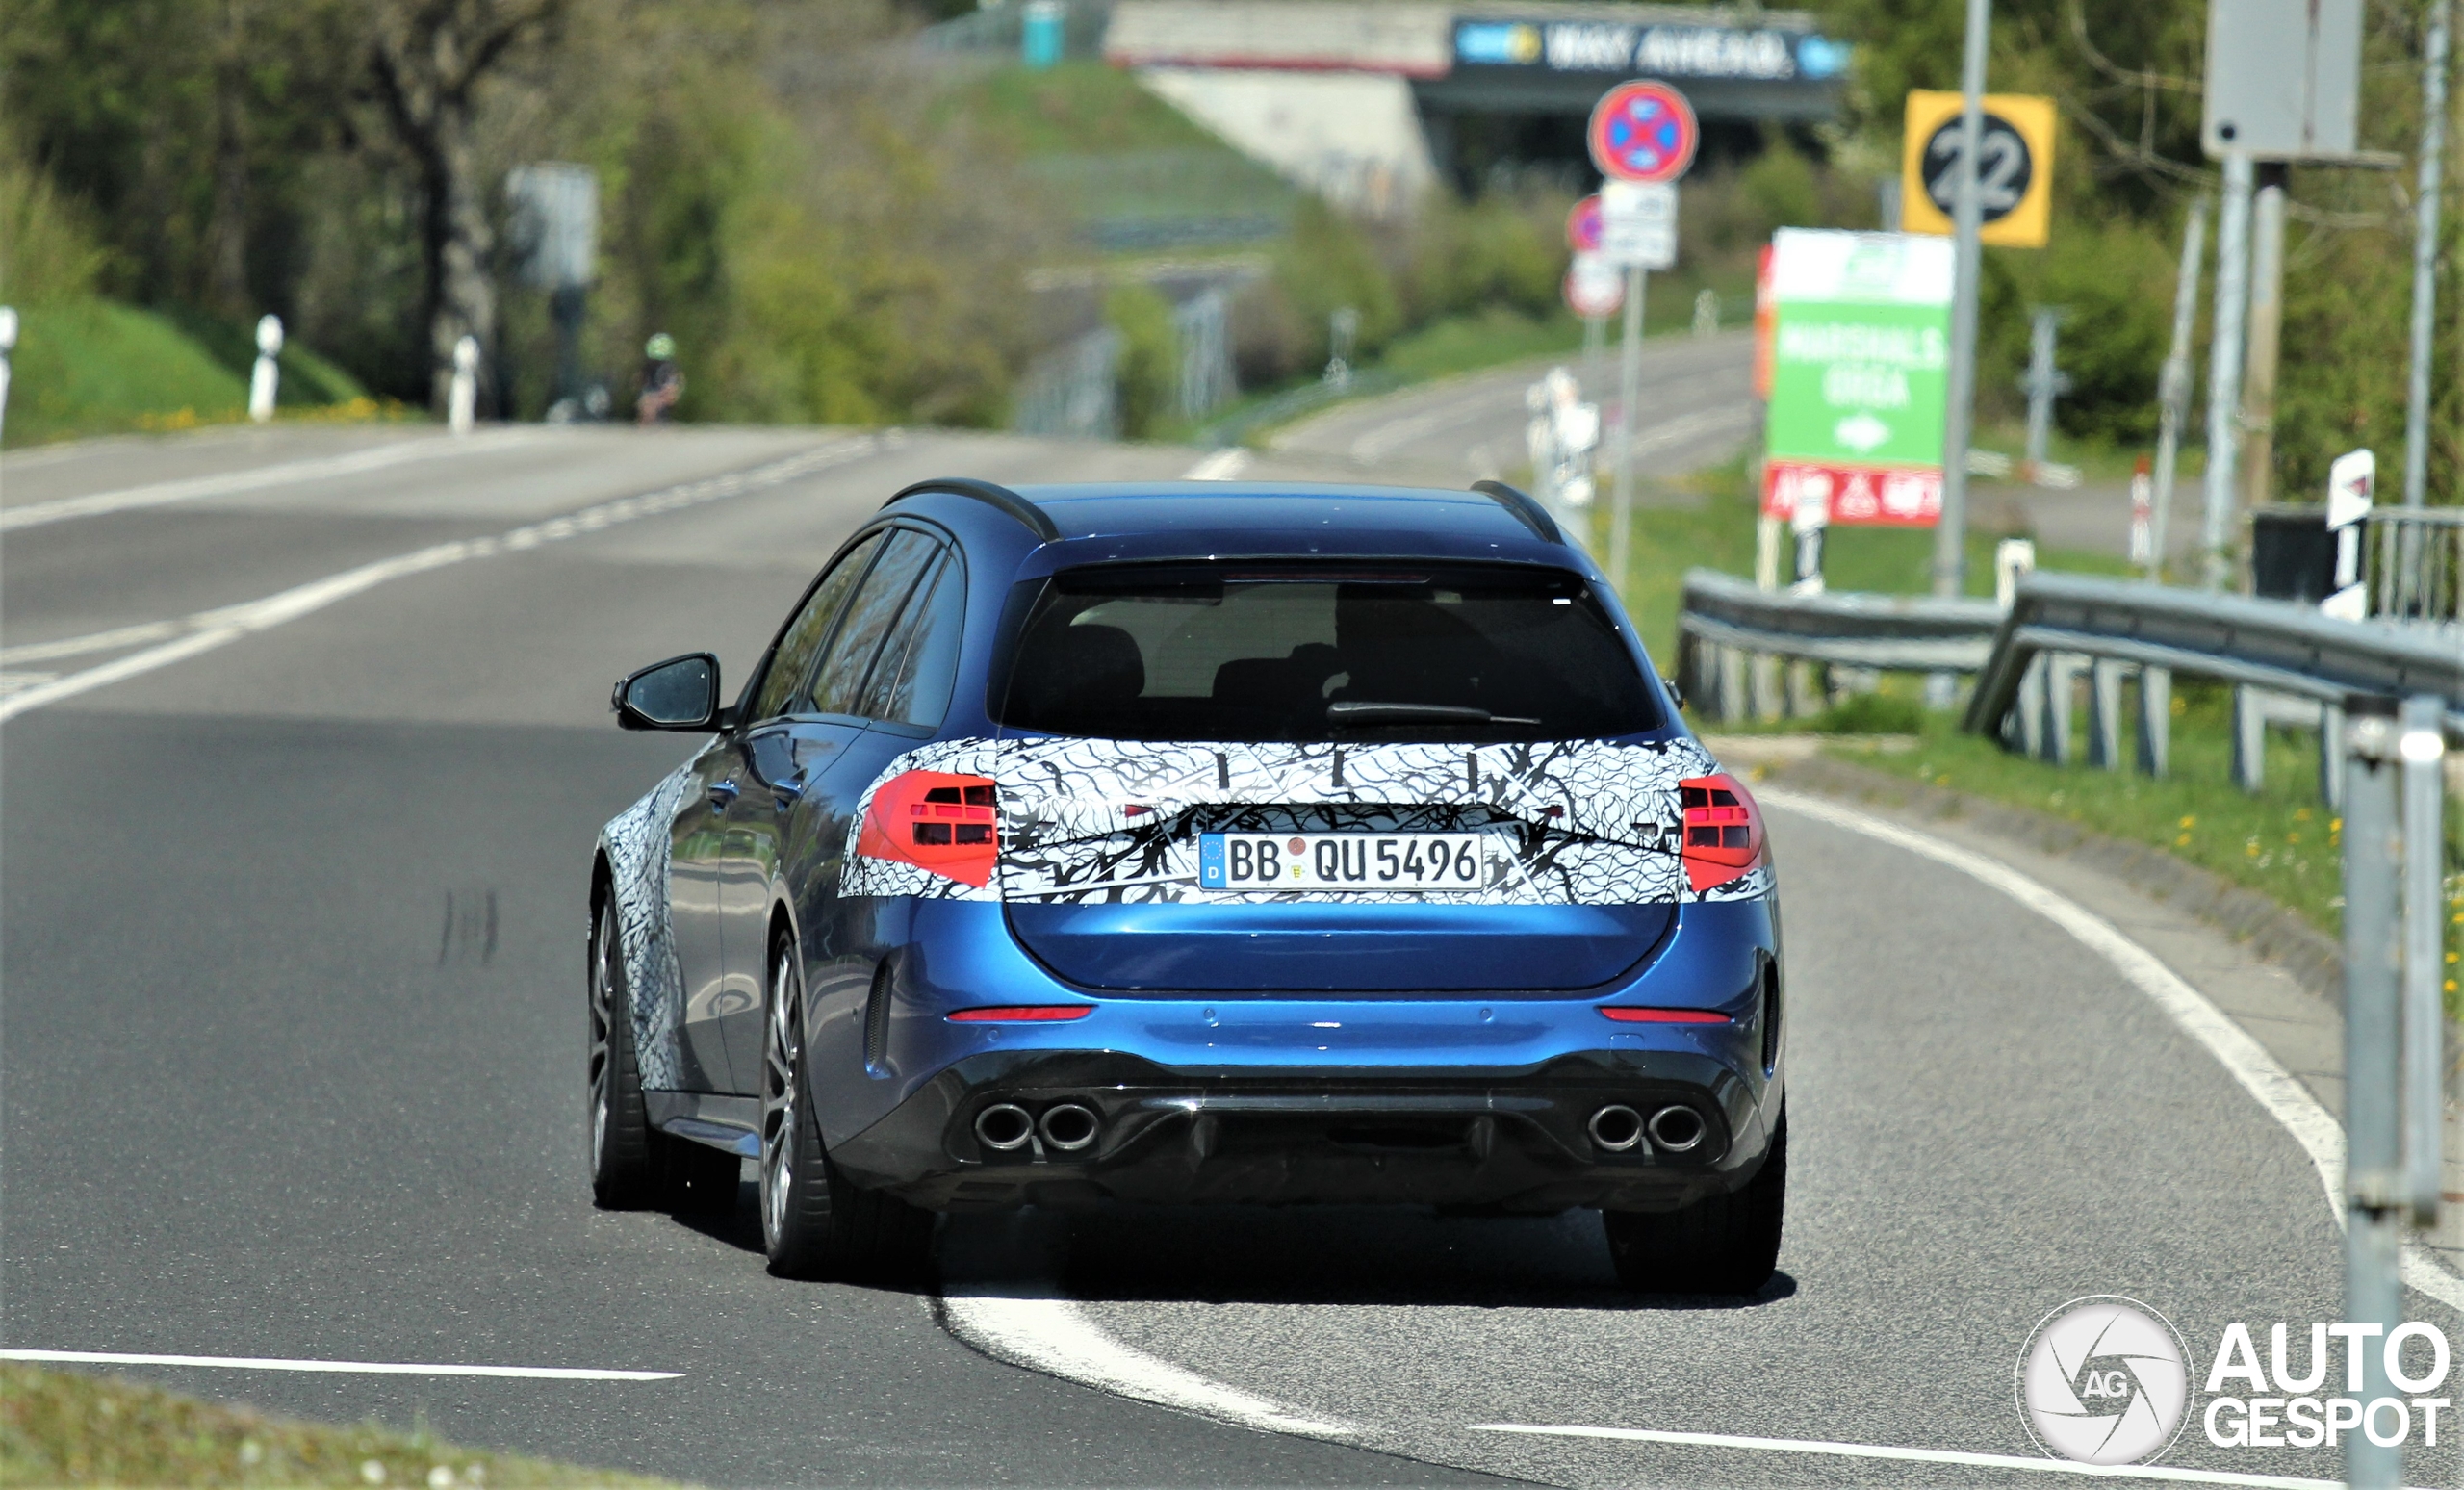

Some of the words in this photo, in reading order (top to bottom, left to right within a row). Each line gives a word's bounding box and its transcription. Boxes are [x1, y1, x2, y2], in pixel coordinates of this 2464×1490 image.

[1545, 22, 1634, 71] WAY
[1931, 126, 2023, 209] 22
[1207, 866, 1219, 880] D
[1230, 839, 1281, 881] BB
[1315, 839, 1367, 881] QU
[1376, 839, 1476, 882] 5496
